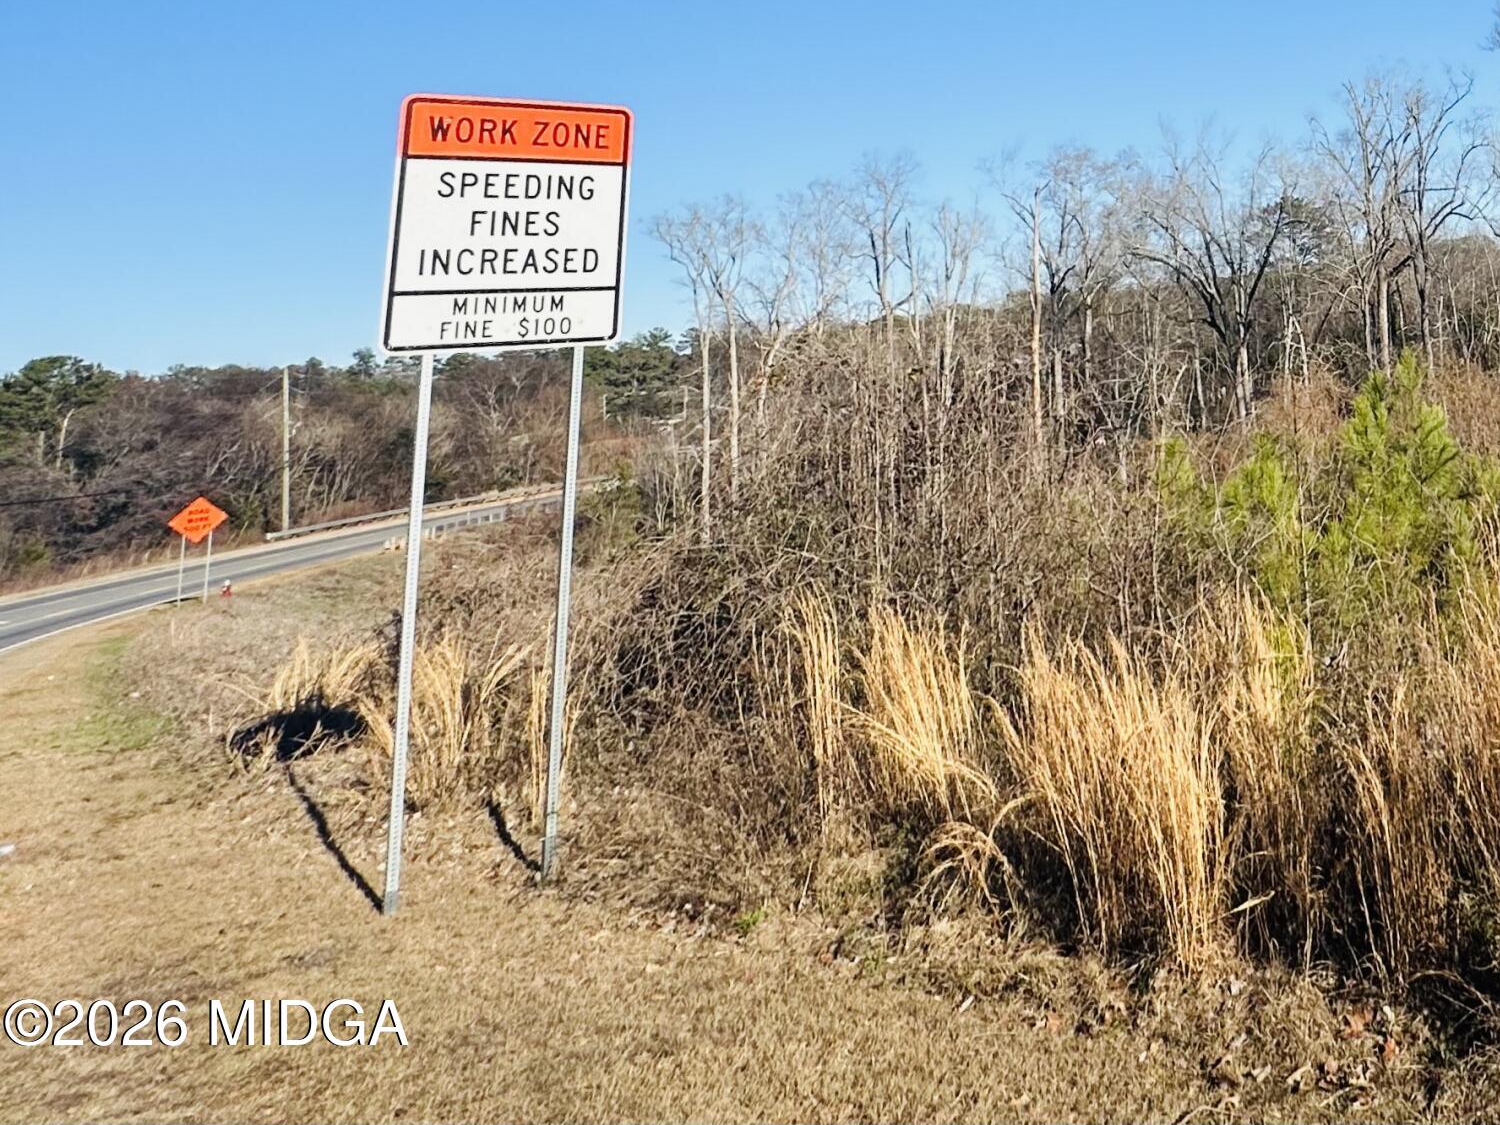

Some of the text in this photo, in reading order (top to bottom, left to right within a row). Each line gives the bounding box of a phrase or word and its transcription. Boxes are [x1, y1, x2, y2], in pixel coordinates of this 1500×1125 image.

[429, 116, 610, 149] WORK ZONE
[437, 172, 595, 200] SPEEDING
[470, 211, 560, 237] FINES
[419, 249, 599, 276] INCREASED
[453, 295, 565, 315] MINIMUM
[440, 317, 571, 339] FINE $100
